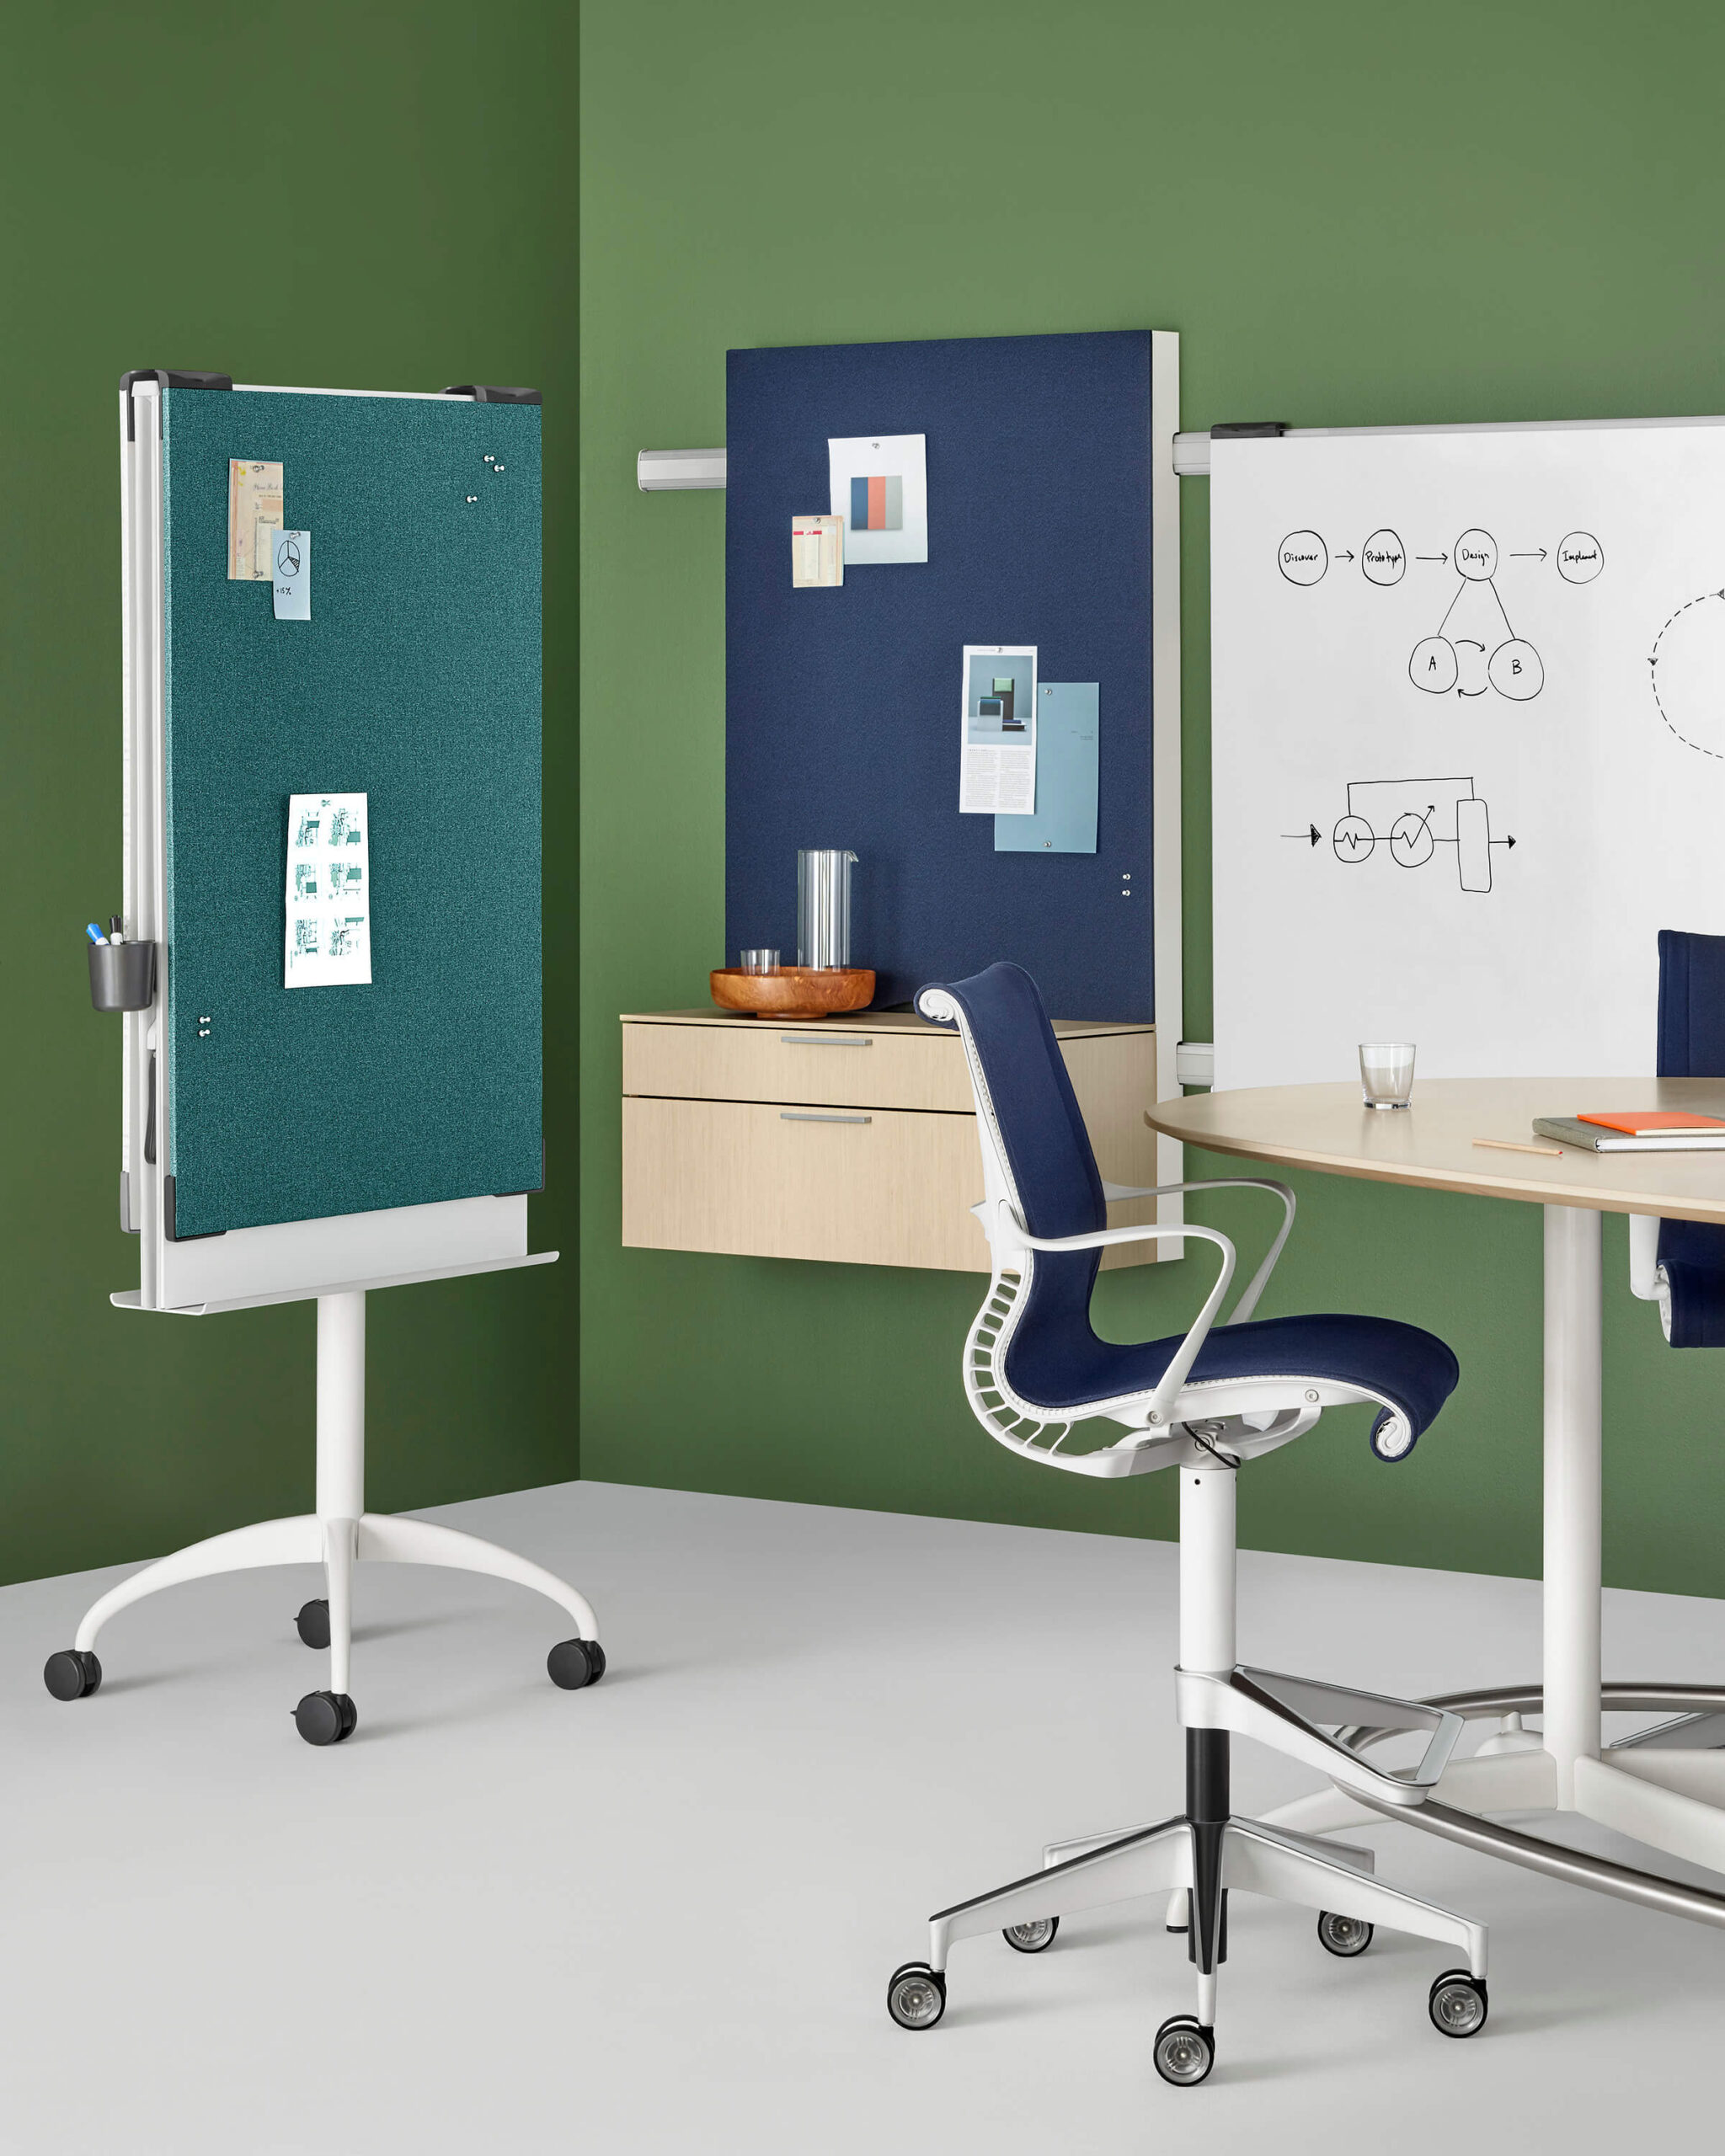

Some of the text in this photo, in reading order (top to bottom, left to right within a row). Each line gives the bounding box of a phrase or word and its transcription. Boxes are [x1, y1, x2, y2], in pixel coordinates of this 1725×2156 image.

[1284, 552, 1318, 563] Discover
[1462, 548, 1490, 567] Design
[1429, 655, 1437, 672] A
[1511, 659, 1523, 675] B
